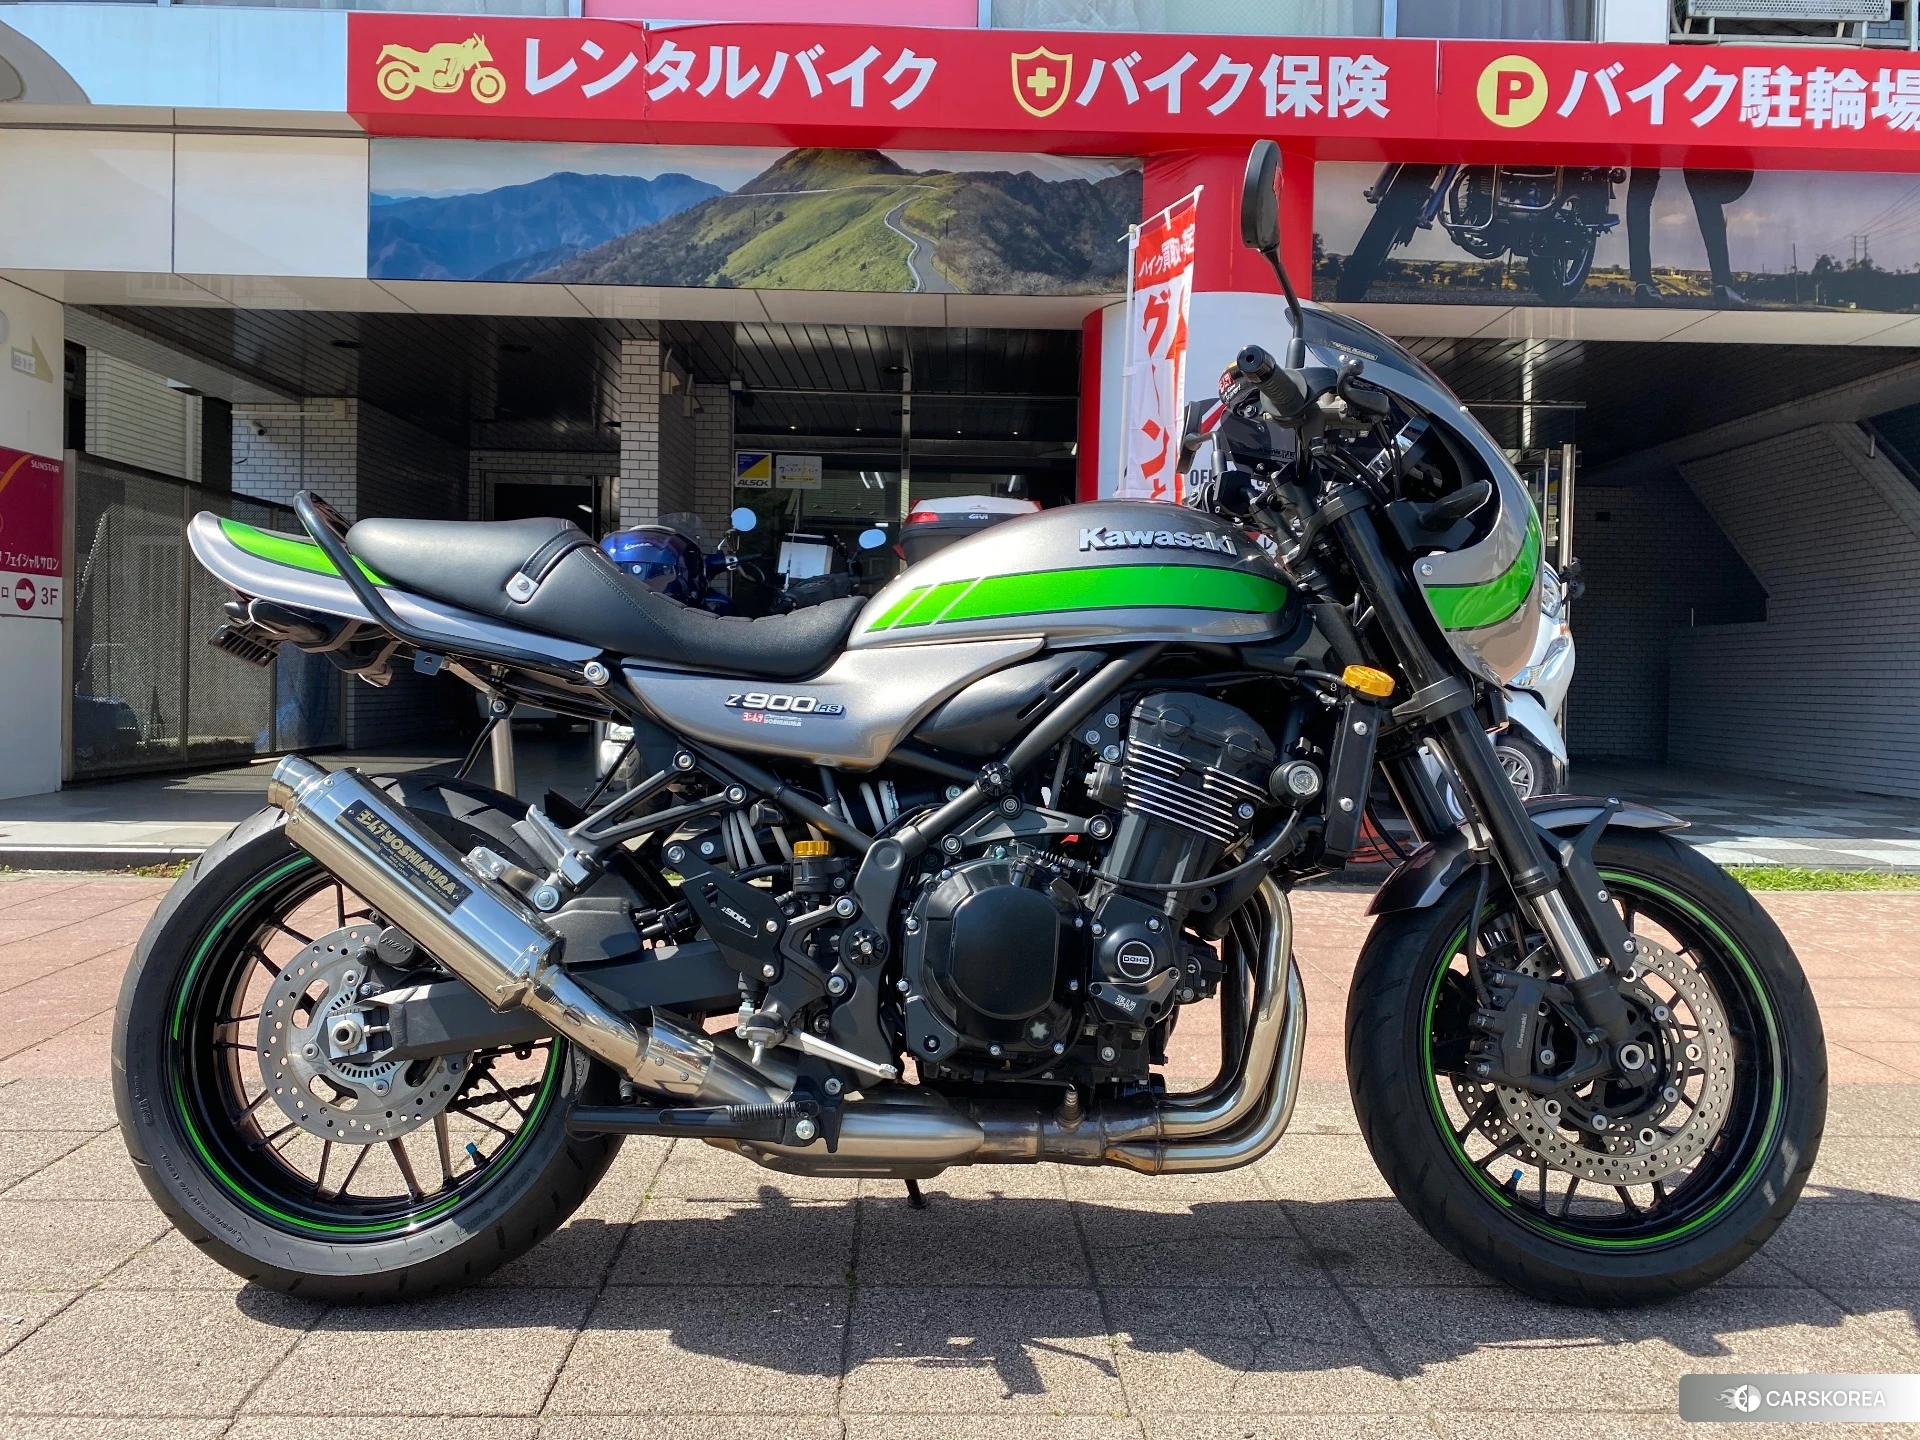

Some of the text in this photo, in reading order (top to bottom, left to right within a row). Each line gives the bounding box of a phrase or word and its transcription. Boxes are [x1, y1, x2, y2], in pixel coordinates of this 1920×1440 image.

[525, 37, 937, 110] レンタルバイク
[1075, 50, 1390, 119] バイク保険
[1557, 61, 1920, 131] バイク駐輪場
[31, 460, 60, 473] SUNSTAR
[1079, 527, 1238, 557] Kawasaki
[41, 587, 59, 606] 3F
[380, 828, 457, 895] YOSHIMURA
[1123, 955, 1149, 964] DOHC
[1516, 1013, 1528, 1049] Kawasaki
